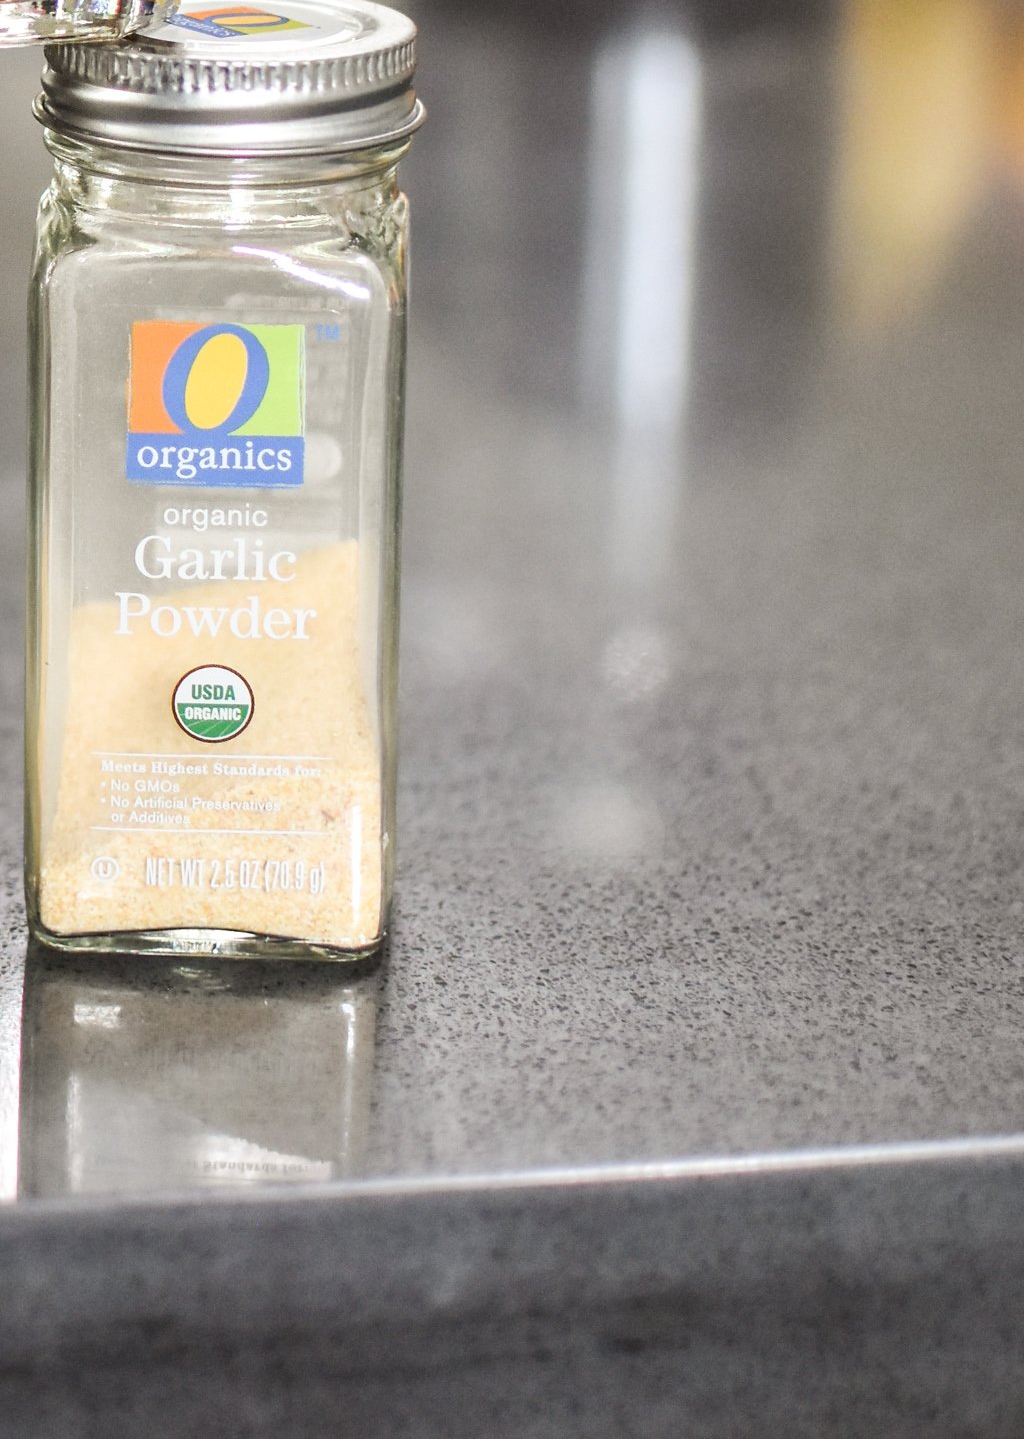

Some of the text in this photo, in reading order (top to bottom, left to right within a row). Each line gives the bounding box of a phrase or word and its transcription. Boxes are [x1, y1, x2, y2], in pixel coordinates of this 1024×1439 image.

[136, 441, 292, 479] organics
[163, 503, 269, 531] organic
[134, 535, 297, 582] Garlic
[113, 591, 318, 640] Powder
[191, 684, 236, 701] USDA
[184, 706, 242, 722] ORGANIC
[100, 760, 146, 774] Meets
[151, 761, 208, 777] Highest
[213, 763, 290, 778] Standards
[111, 780, 180, 793] No GMOs
[111, 797, 129, 808] No
[134, 796, 188, 810] Artificial
[111, 811, 190, 825] or Additives
[145, 857, 175, 886] NET
[179, 858, 206, 887] WT
[210, 858, 234, 888] 2.5
[239, 860, 261, 889] OZ
